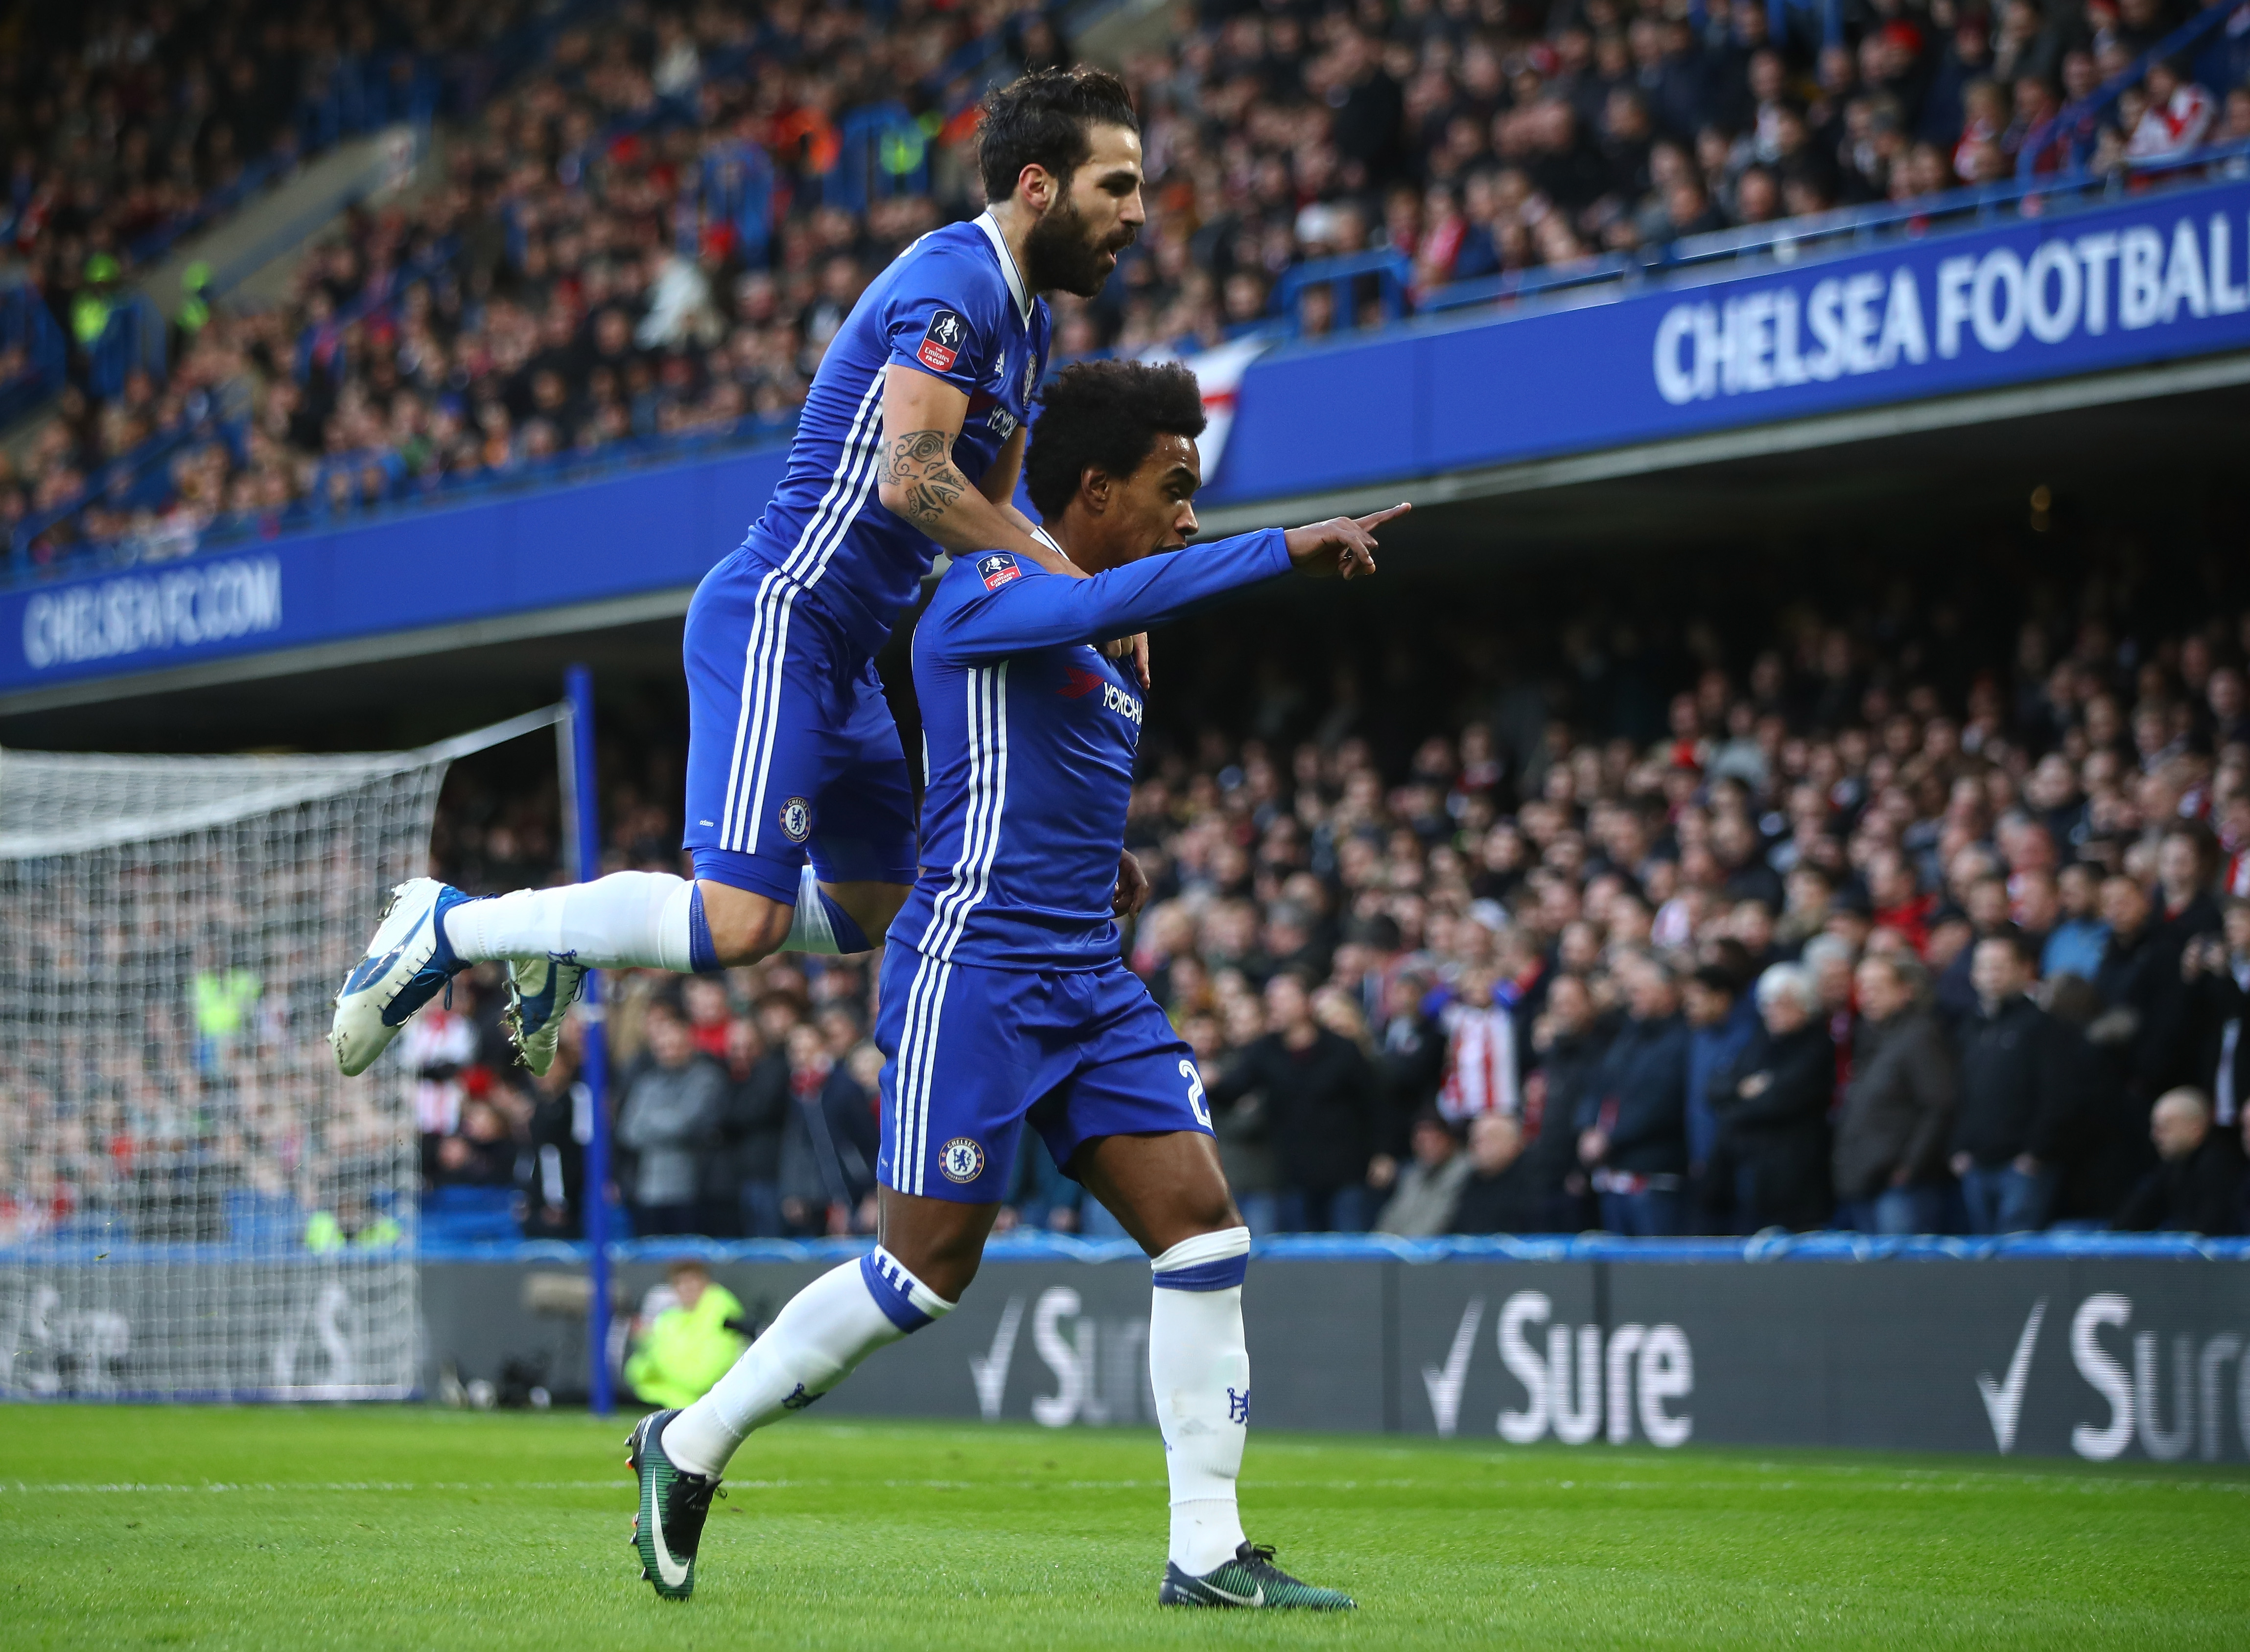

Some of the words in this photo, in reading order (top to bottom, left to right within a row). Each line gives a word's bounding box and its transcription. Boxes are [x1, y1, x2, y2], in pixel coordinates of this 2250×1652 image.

[1653, 265, 1929, 406] CHELSEA
[1936, 209, 2250, 360] FOOTBAL
[924, 347, 949, 363] Emirates
[990, 572, 1015, 586] Emirates
[788, 799, 808, 811] CHELSEA
[1178, 1060, 1214, 1131] 2
[947, 1140, 976, 1150] CHELSEA
[1496, 1288, 1693, 1448] Sure
[2069, 1290, 2250, 1463] Sur
